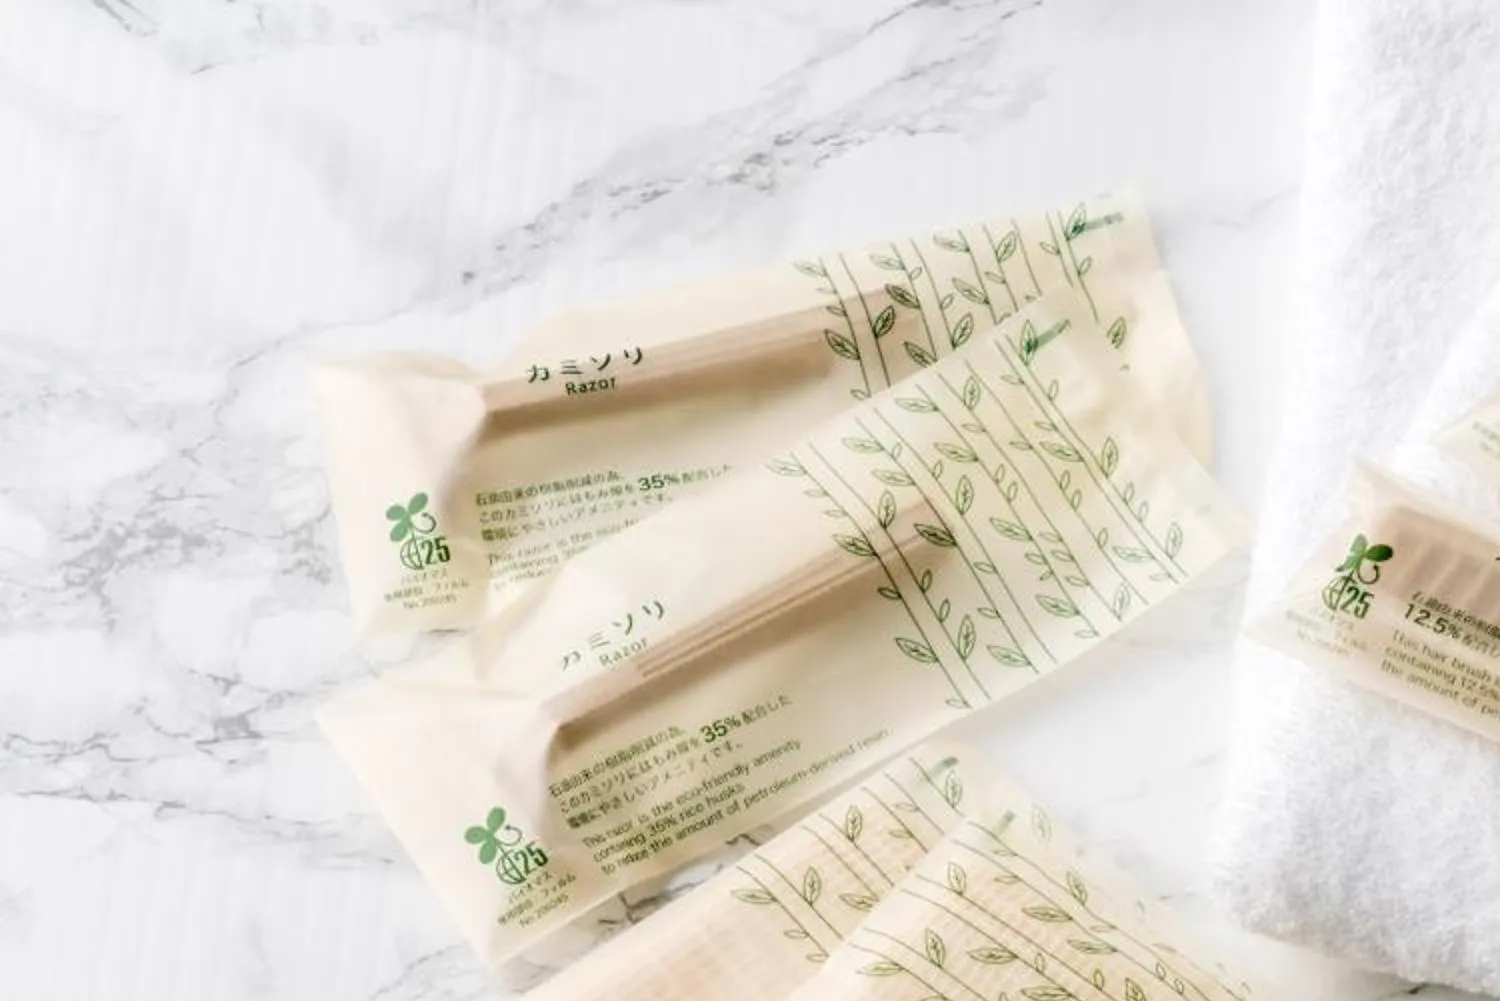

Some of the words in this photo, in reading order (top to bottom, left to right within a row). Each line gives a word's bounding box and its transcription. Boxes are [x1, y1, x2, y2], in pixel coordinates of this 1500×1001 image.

[526, 347, 643, 384] カミソリ
[565, 377, 616, 396] Razor
[420, 535, 451, 565] 25
[1340, 586, 1373, 618] 25
[561, 600, 665, 671] カミソリ
[599, 637, 648, 667] Razor
[645, 814, 677, 837] 35%
[515, 841, 549, 875] 25
